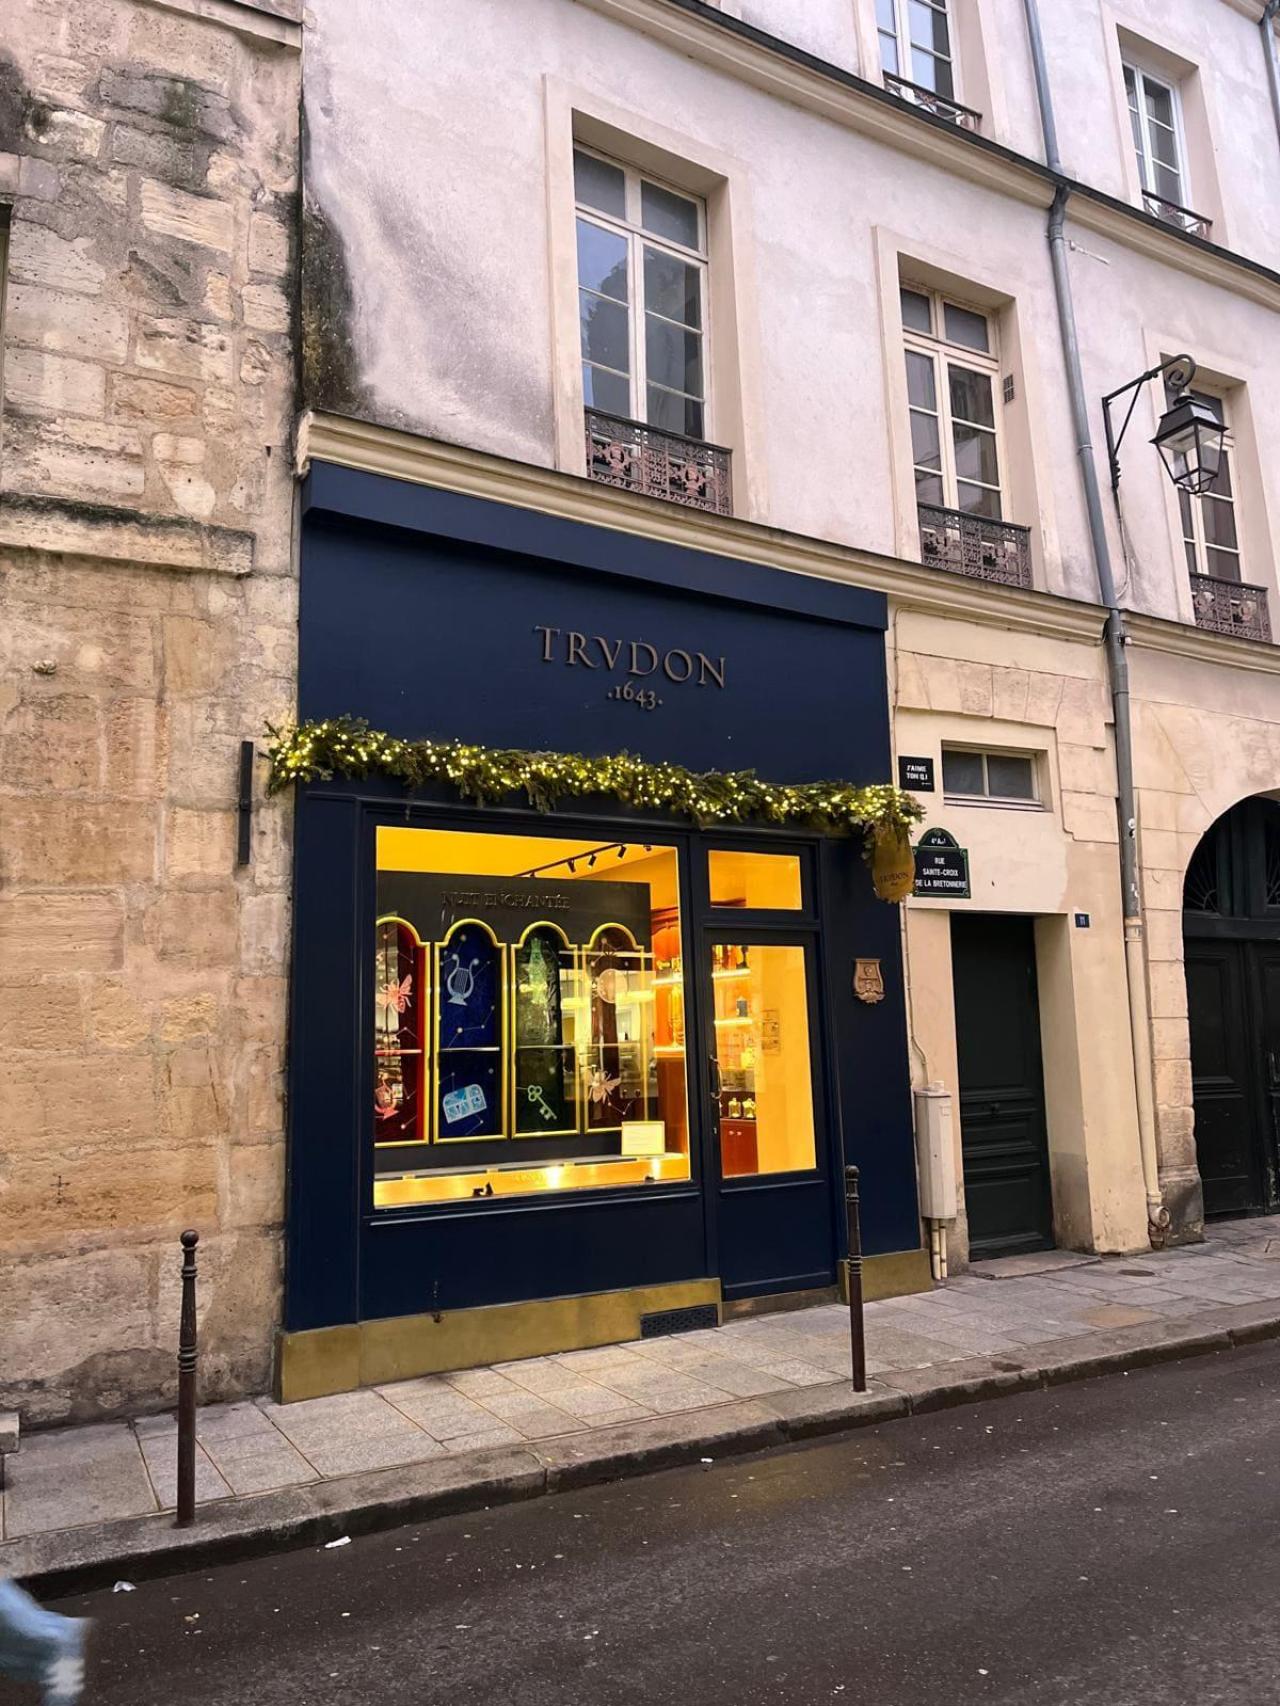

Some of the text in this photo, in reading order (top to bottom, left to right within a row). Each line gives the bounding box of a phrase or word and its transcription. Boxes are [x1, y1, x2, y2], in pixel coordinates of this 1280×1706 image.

[535, 625, 727, 689] TRVDON
[934, 857, 945, 865] RUE
[922, 868, 959, 877] SAINTE-CROIX
[915, 879, 967, 888] DE LA BRETONNERIE
